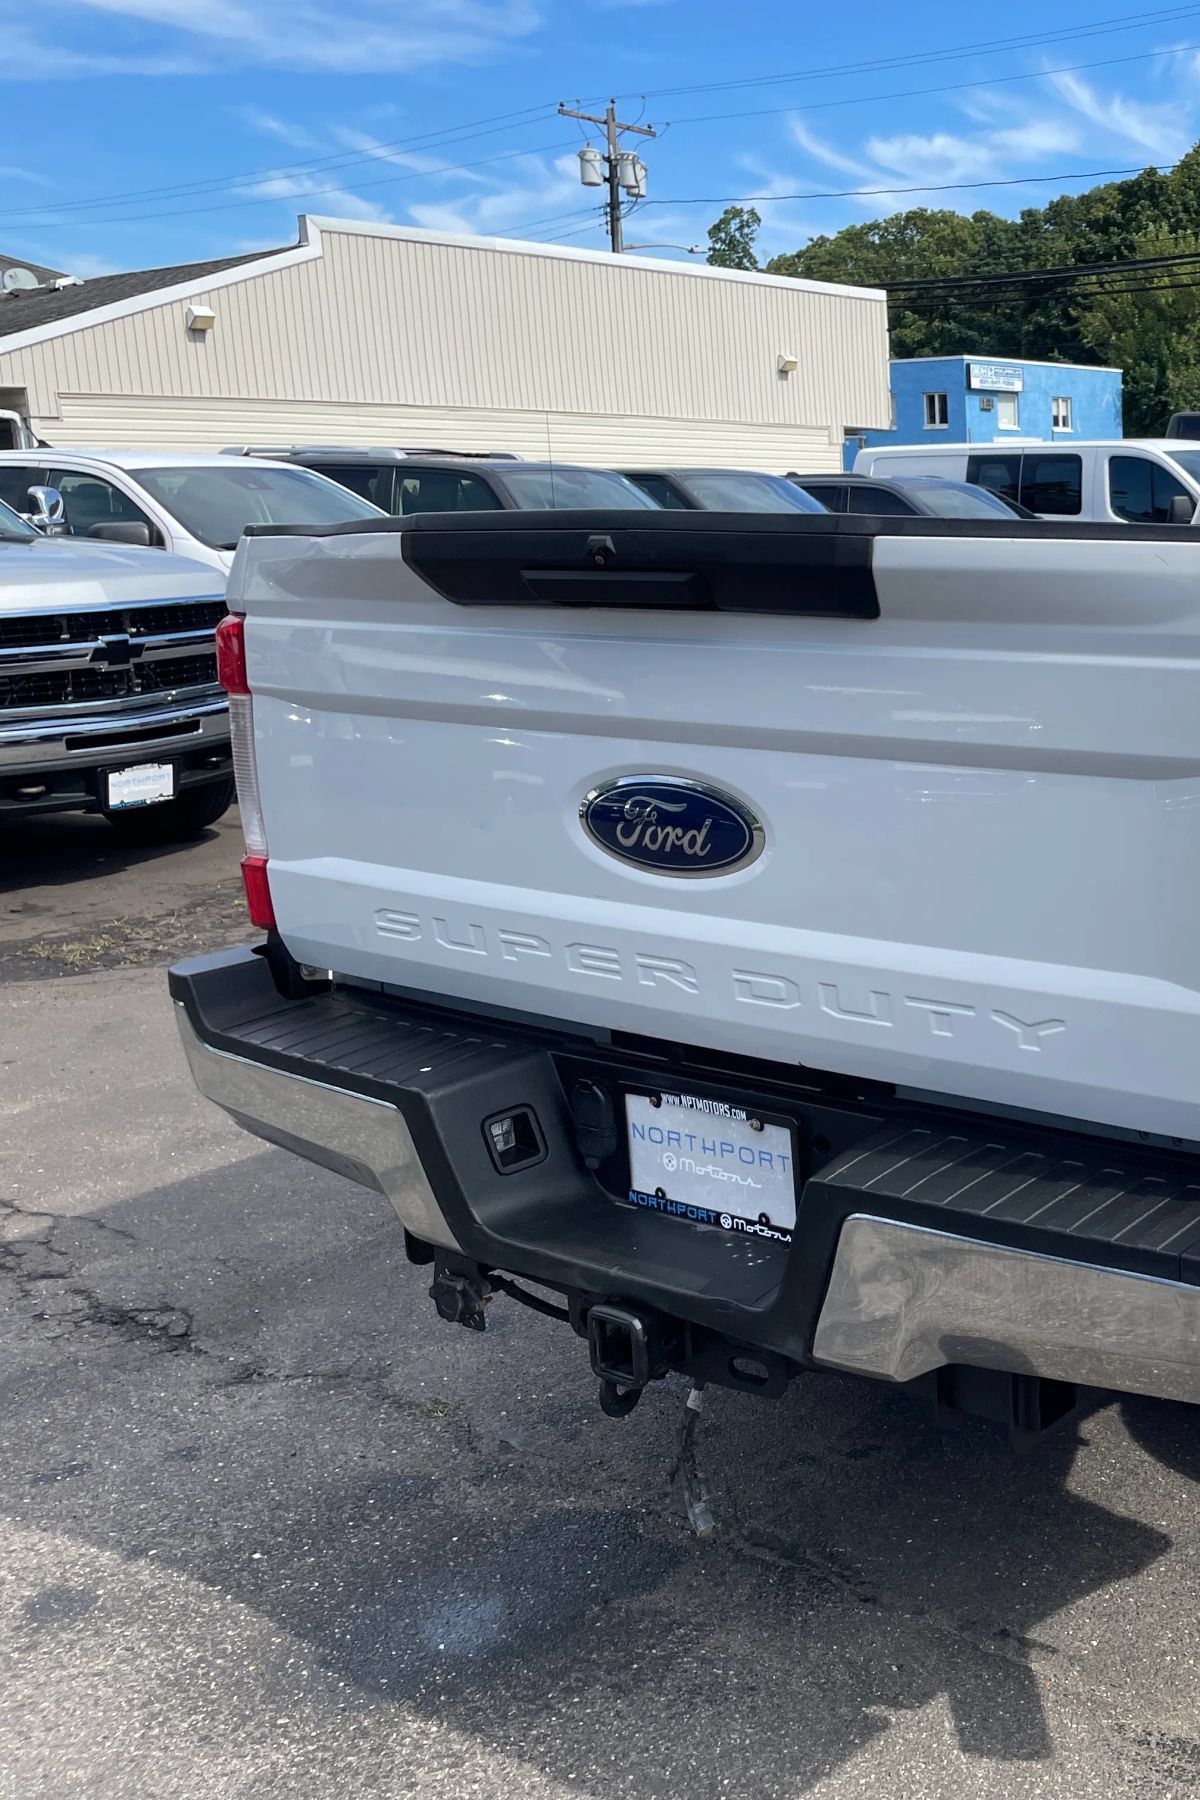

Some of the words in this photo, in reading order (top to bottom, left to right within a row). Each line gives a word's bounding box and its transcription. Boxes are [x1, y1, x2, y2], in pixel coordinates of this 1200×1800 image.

[616, 795, 712, 858] Ford
[374, 908, 699, 994] SUPER
[732, 967, 1066, 1052] DUTY
[660, 1093, 747, 1122] WWW.NPTMOTORS.COM
[632, 1122, 790, 1173] NORTHPORT
[679, 1158, 762, 1189] Motors
[628, 1190, 717, 1224] NORTHPORT
[733, 1218, 792, 1243] Motors
